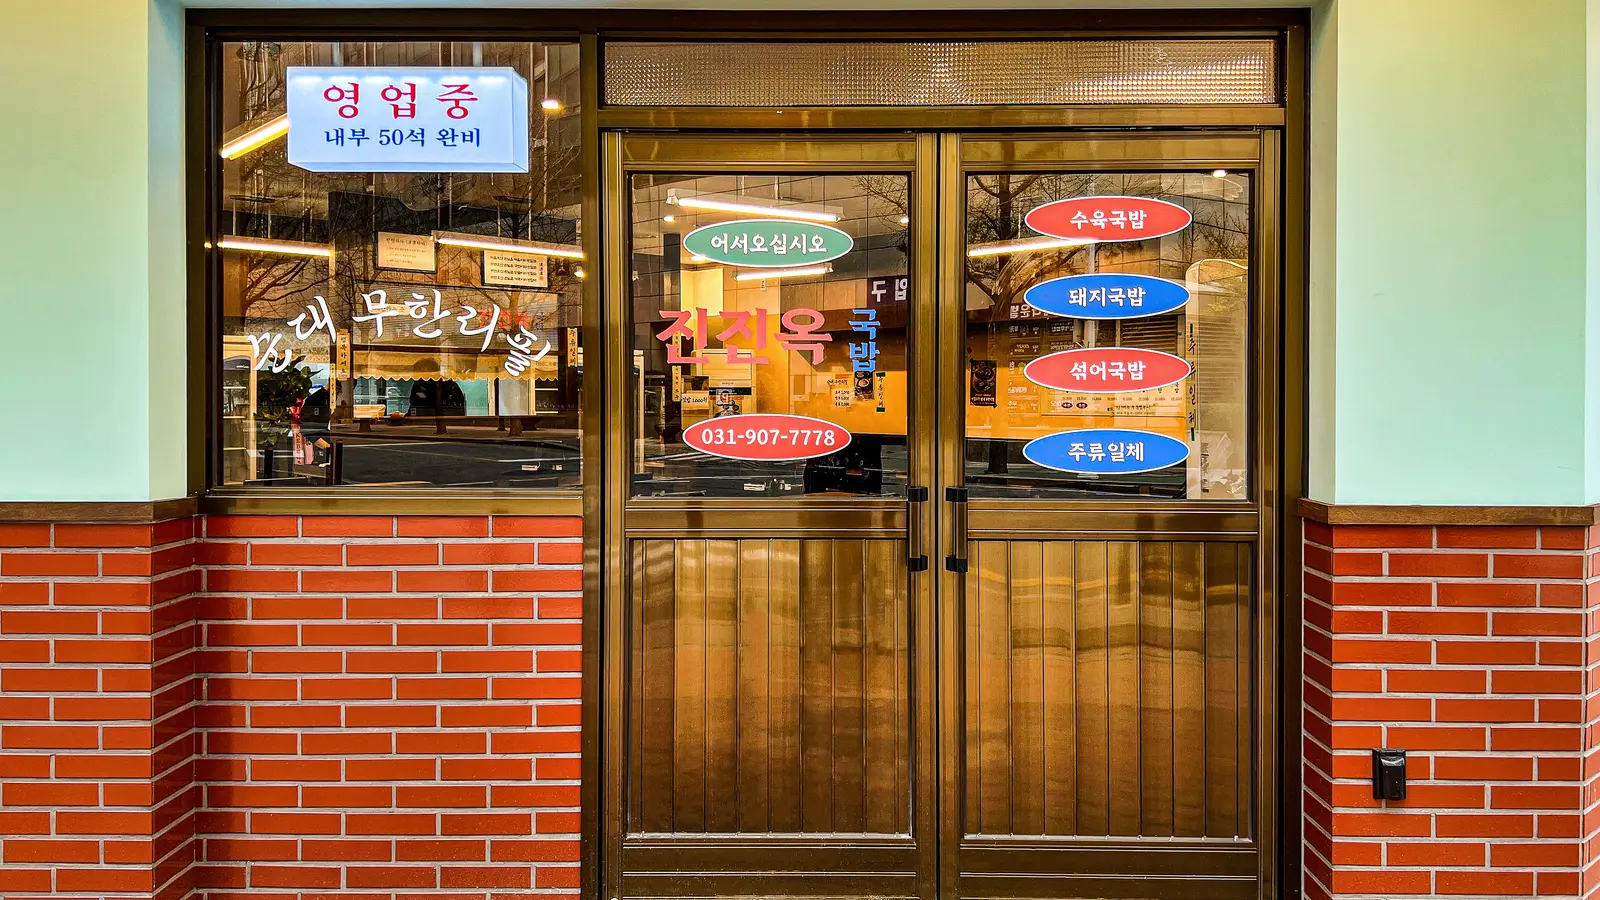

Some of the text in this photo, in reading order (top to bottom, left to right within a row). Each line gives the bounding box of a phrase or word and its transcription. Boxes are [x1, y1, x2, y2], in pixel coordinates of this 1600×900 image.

[324, 128, 481, 147] 내부 50석 완비
[1069, 209, 1148, 230] 수육국밥
[710, 232, 828, 255] 어서오십시오
[1068, 286, 1147, 307] 돼지국밥
[656, 306, 832, 366] 진진옥
[848, 308, 881, 373] 국밥
[1069, 361, 1147, 382] 섞어국밥
[700, 428, 836, 447] 031-907-7778
[1068, 442, 1145, 463] 주류일체
